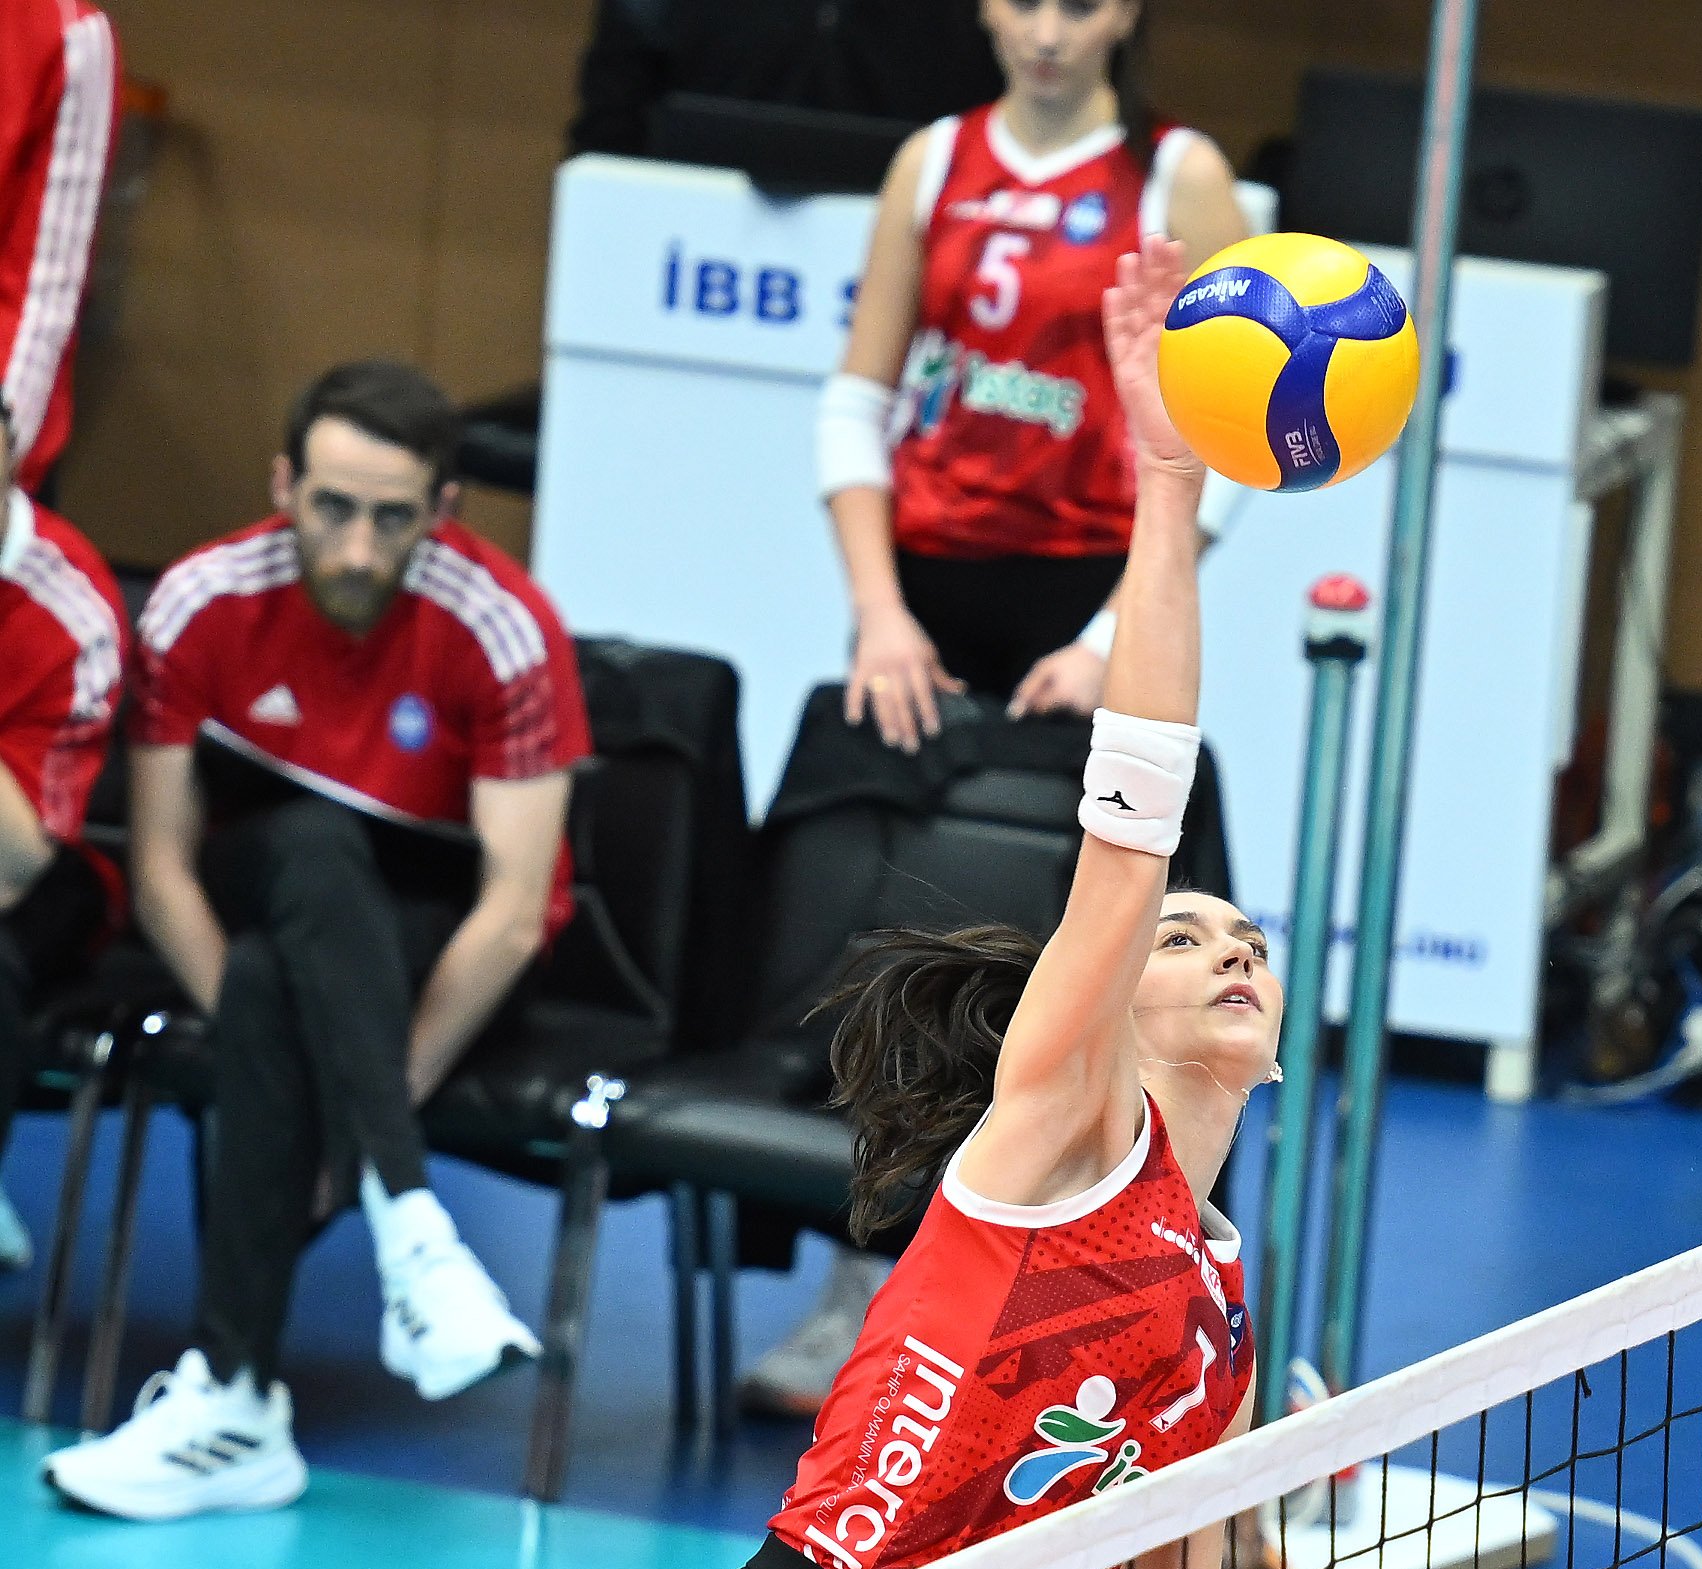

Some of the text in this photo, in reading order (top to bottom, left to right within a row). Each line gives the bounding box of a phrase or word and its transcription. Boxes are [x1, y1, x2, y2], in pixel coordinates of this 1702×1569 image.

[664, 238, 803, 324] İBB
[968, 231, 1032, 331] 5
[1284, 430, 1311, 469] FIVB
[846, 1465, 867, 1492] YEN
[815, 1494, 840, 1525] OLU
